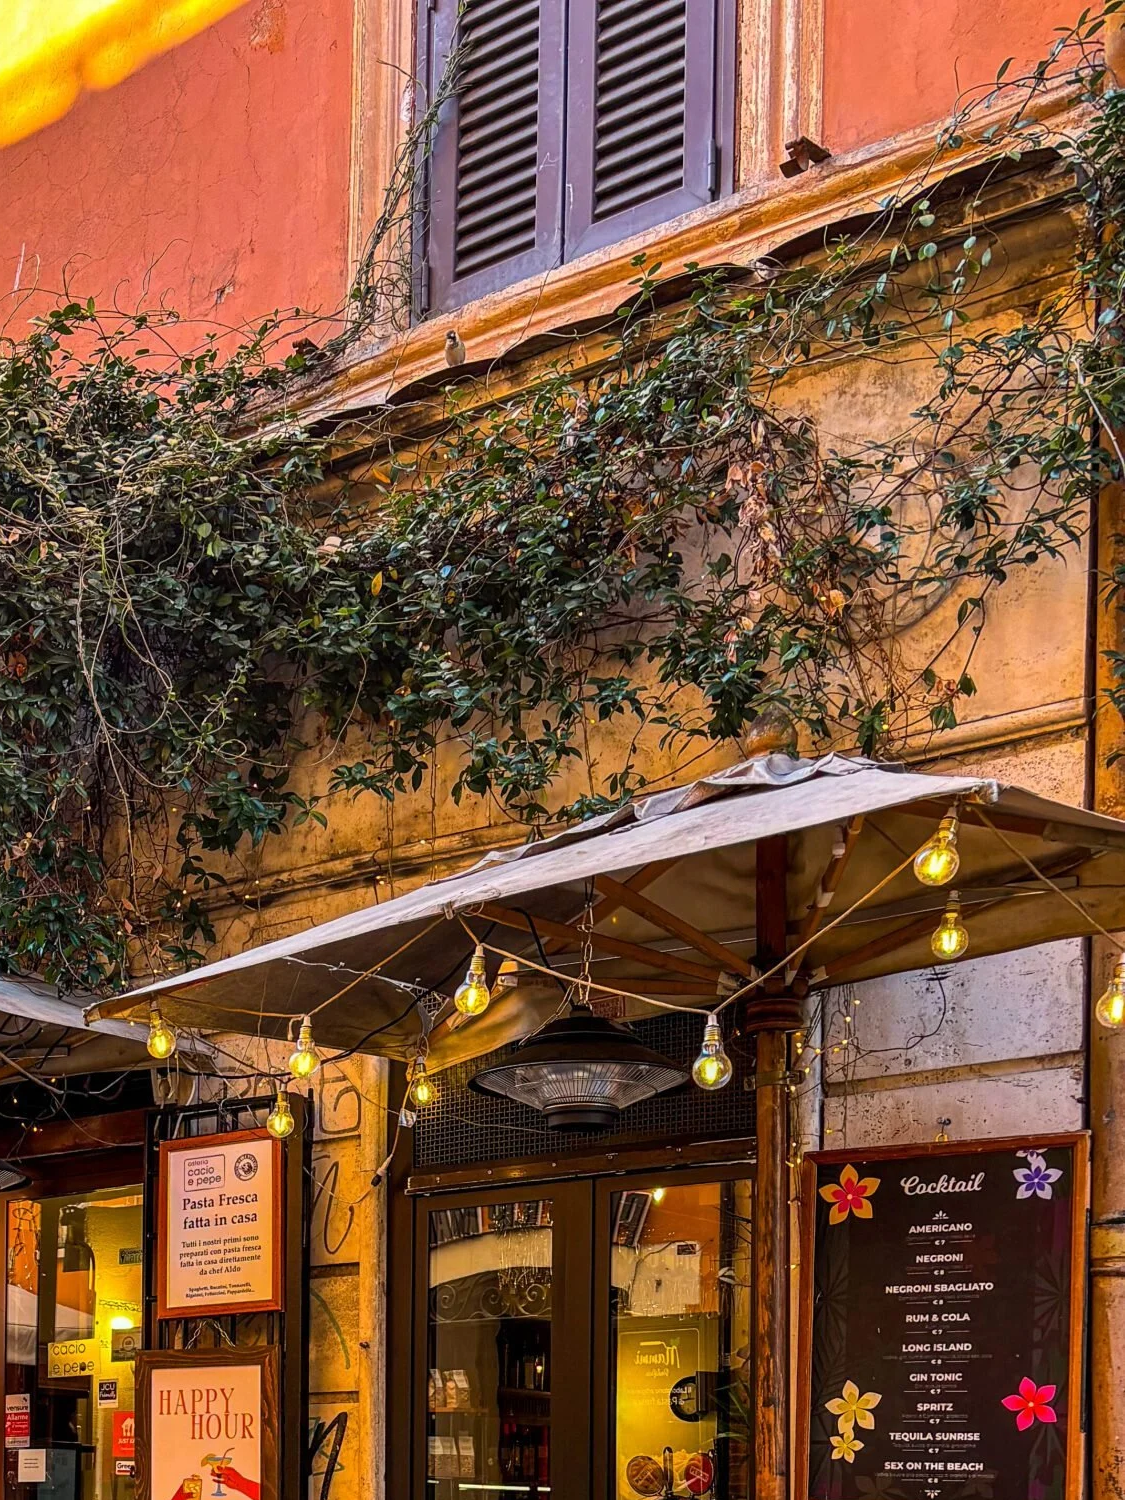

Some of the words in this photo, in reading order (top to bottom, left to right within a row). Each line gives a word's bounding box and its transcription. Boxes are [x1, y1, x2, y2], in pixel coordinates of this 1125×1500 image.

[187, 1159, 209, 1168] osteria
[187, 1165, 215, 1177] cacio
[187, 1178, 194, 1186] e
[196, 1175, 222, 1187] pepe
[900, 1171, 986, 1196] Cocktail
[182, 1196, 215, 1211] Pasta
[219, 1192, 259, 1207] Fresca
[183, 1216, 211, 1230] fatta
[215, 1213, 228, 1227] in
[231, 1212, 258, 1225] casa
[908, 1222, 973, 1234] AMERICANO
[181, 1241, 197, 1249] Tutti
[203, 1237, 222, 1247] nostri
[223, 1236, 242, 1246] primi
[179, 1249, 209, 1260] preparati
[210, 1248, 222, 1256] con
[223, 1246, 241, 1256] pasta
[242, 1244, 262, 1252] fresca
[915, 1253, 964, 1263] NEGRONI
[180, 1260, 195, 1268] fatta
[204, 1258, 218, 1266] casa
[219, 1254, 262, 1264] direttamente
[199, 1268, 208, 1276] da
[208, 1266, 223, 1275] chef
[224, 1265, 241, 1274] Aldo
[885, 1284, 932, 1294] NEGRONI
[933, 1282, 994, 1292] SBAGLIATO
[905, 1314, 930, 1323] RUM
[931, 1314, 940, 1322] &
[941, 1313, 971, 1322] COLA
[52, 1342, 86, 1356] cacio
[902, 1344, 931, 1352] LONG
[933, 1343, 972, 1352] ISLAND
[53, 1362, 61, 1374] e
[63, 1360, 95, 1376] pepe
[909, 1373, 928, 1382] GIN
[930, 1373, 963, 1382] TONIC
[100, 1383, 115, 1391] JCU
[158, 1387, 235, 1416] HAPPY
[916, 1403, 954, 1412] SPRITZ
[190, 1411, 255, 1440] HOUR
[889, 1432, 934, 1442] TEQUILA
[935, 1432, 981, 1441] SUNRISE
[884, 1461, 904, 1470] SEX
[906, 1462, 922, 1470] ON
[924, 1462, 945, 1470] THE
[947, 1462, 984, 1471] BEACH
